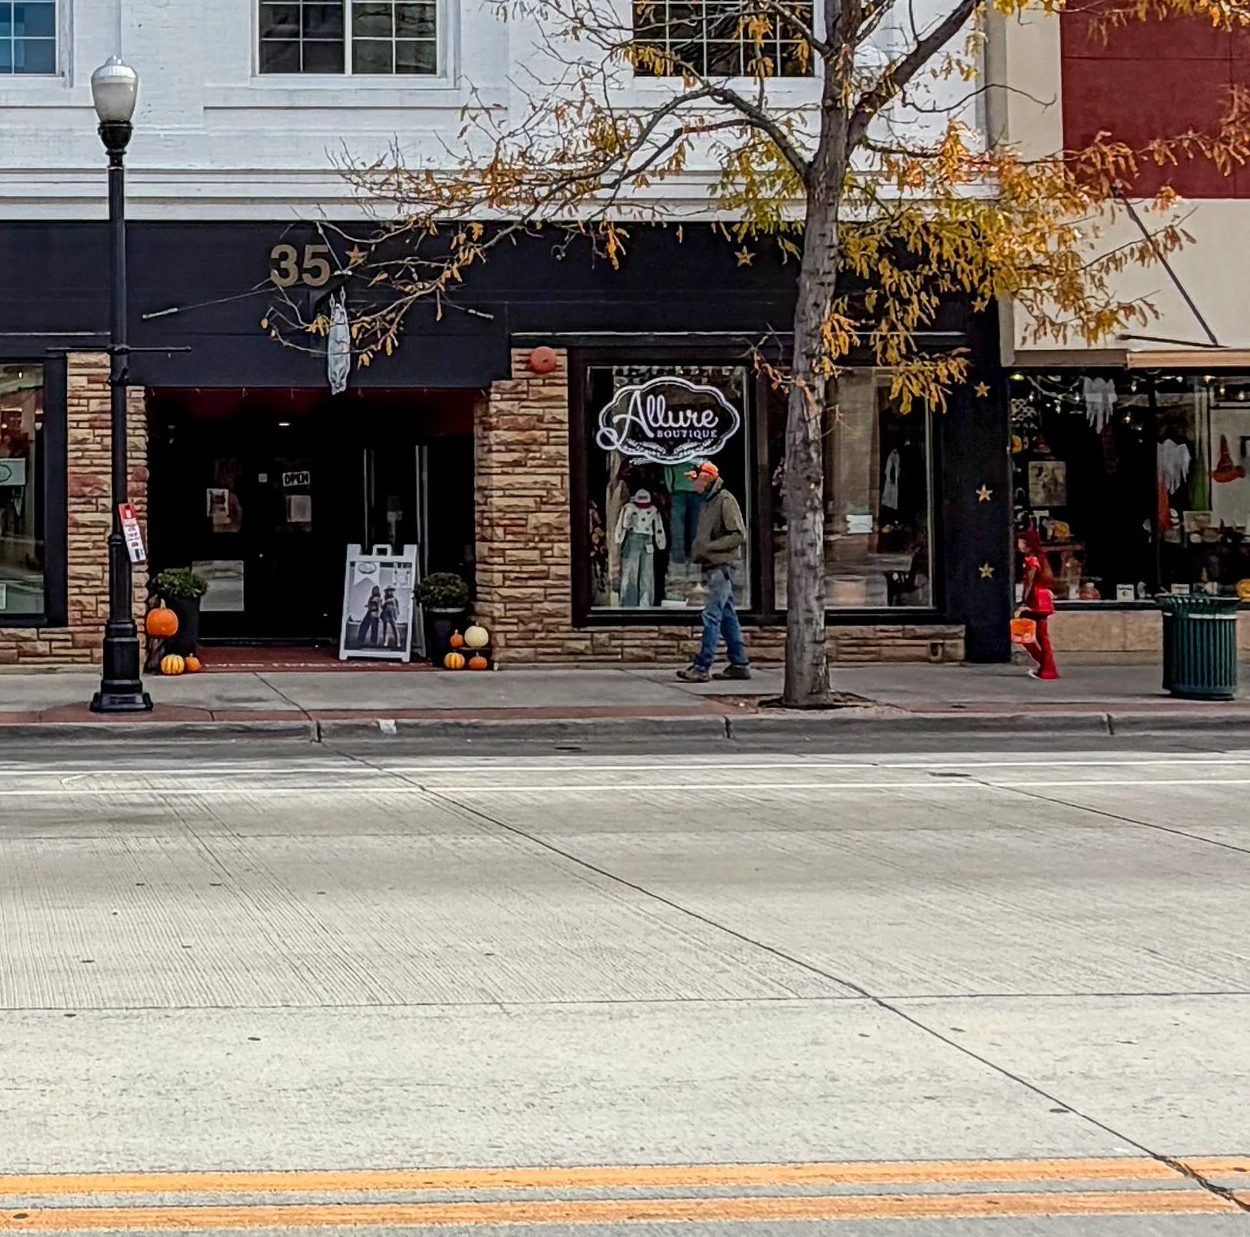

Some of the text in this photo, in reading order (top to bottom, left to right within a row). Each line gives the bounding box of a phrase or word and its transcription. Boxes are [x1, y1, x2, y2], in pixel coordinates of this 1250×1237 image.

[270, 244, 330, 288] 35
[597, 390, 719, 450] Allure
[657, 429, 718, 439] BOUTIQUE
[284, 473, 309, 484] OPEN
